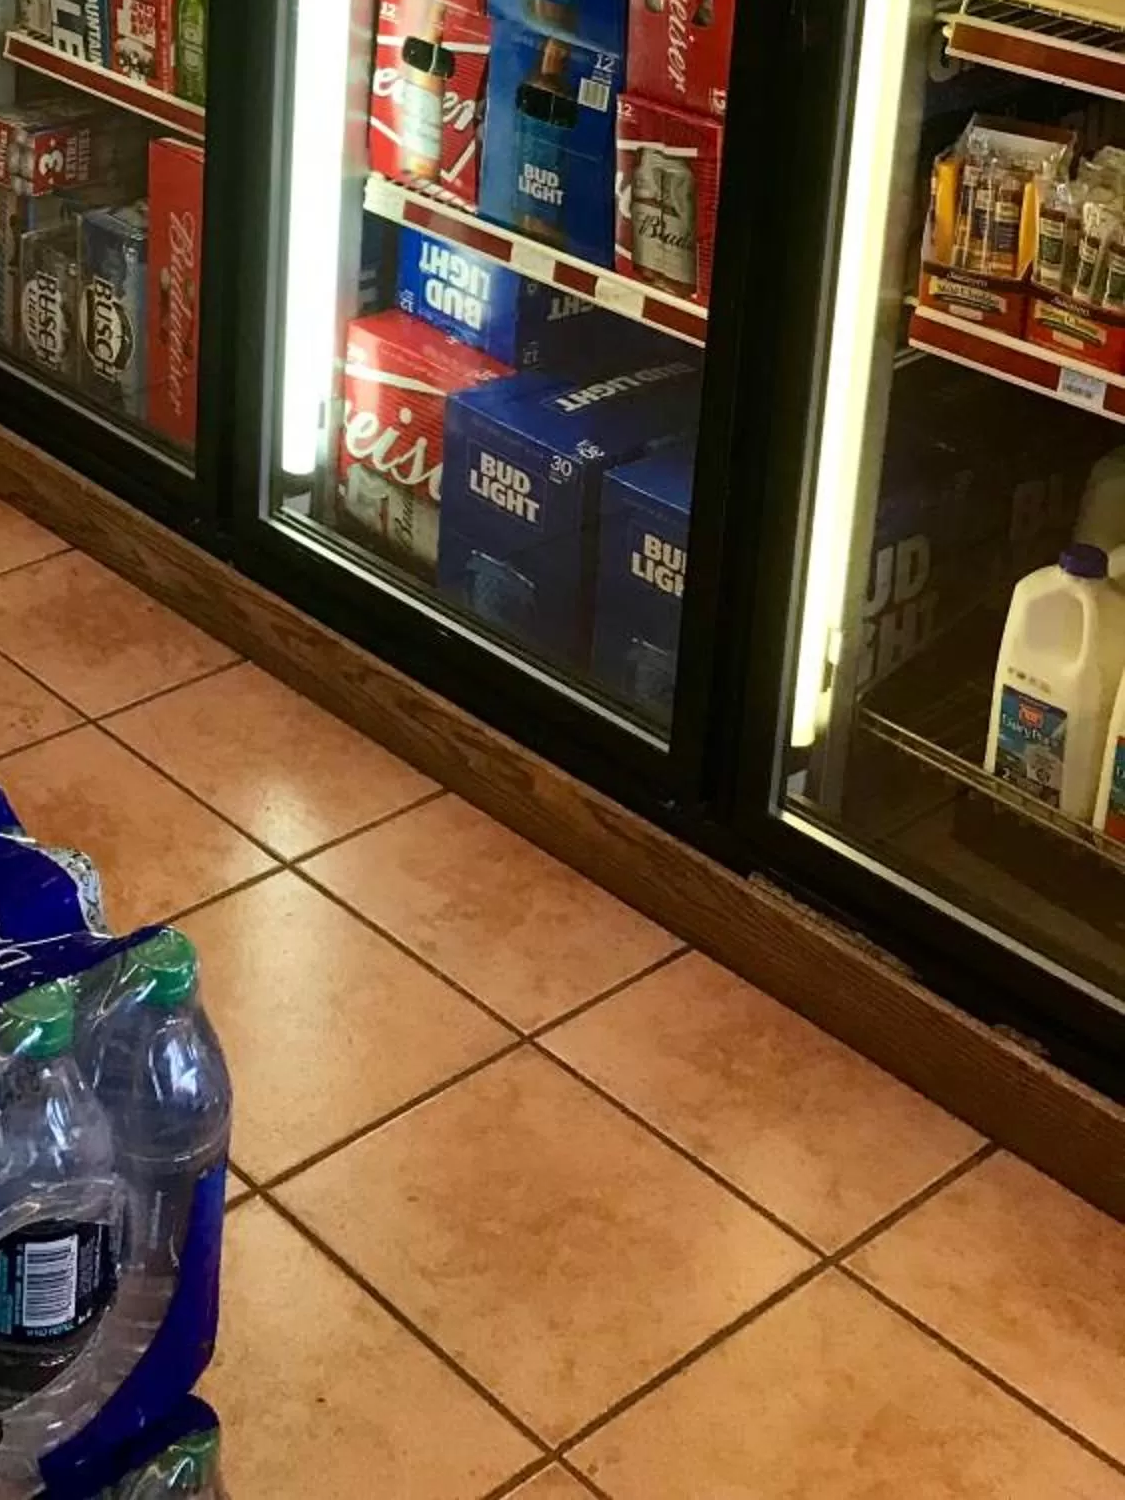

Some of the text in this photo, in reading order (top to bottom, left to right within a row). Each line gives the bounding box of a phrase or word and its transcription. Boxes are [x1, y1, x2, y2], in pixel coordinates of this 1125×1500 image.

[593, 52, 615, 74] 12
[517, 180, 565, 206] LIGHT
[522, 163, 560, 188] BUD
[419, 240, 492, 302] LIGHT
[166, 209, 196, 416] Budweiser
[425, 277, 483, 332] BUD
[90, 276, 123, 384] BUSCH
[554, 375, 642, 412] LIGHT
[478, 450, 533, 496] BUD
[549, 455, 573, 479] 30
[469, 470, 541, 525] LIGHT
